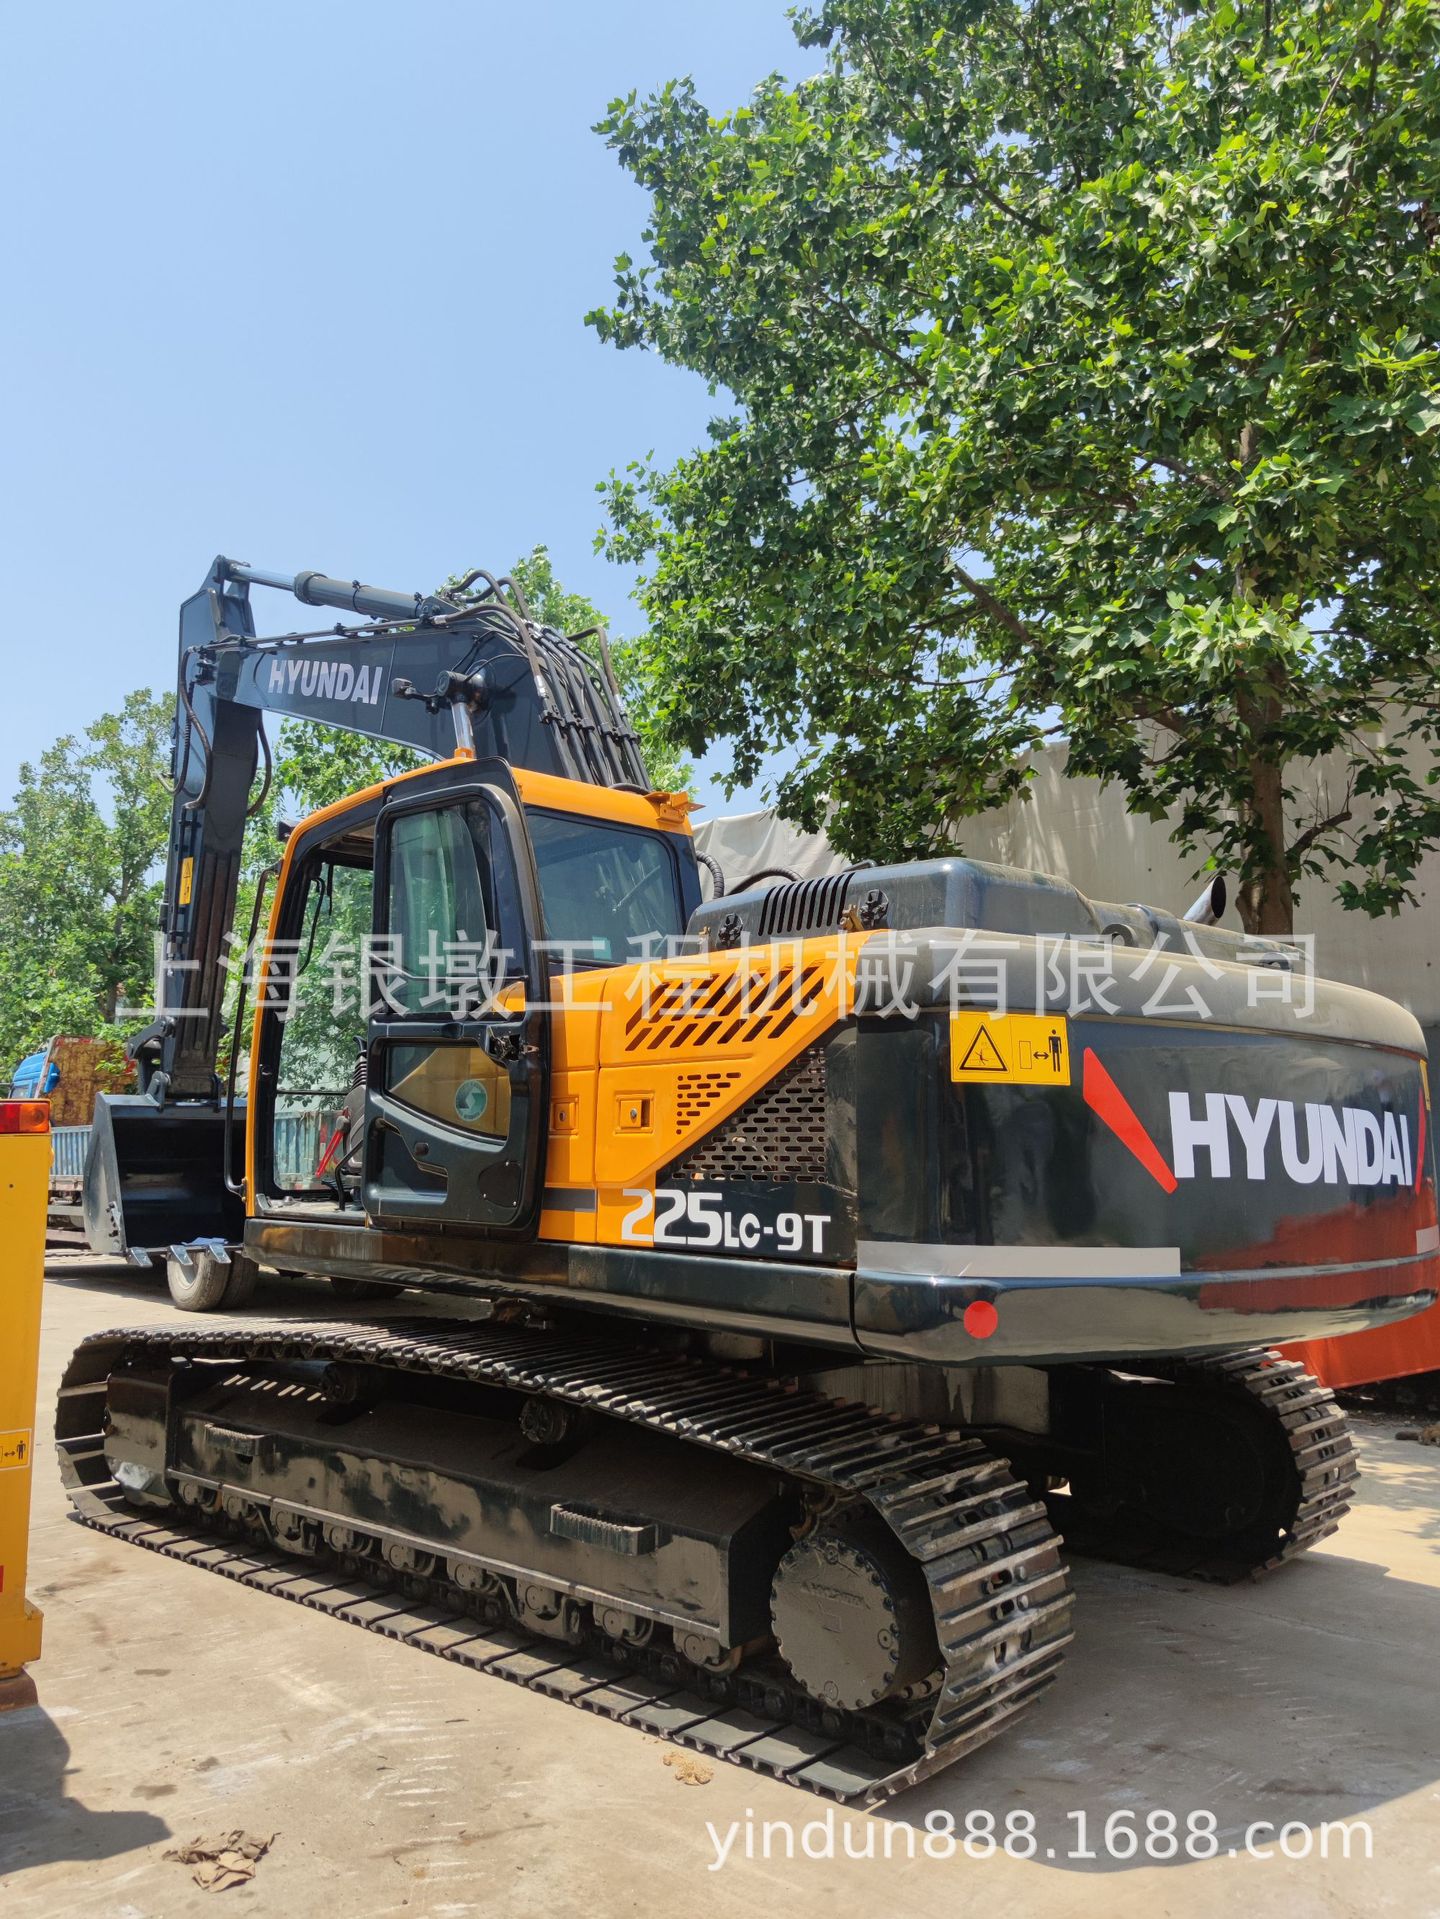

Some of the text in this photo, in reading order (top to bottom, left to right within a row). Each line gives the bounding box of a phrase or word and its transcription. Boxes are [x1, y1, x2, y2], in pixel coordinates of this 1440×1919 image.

[267, 659, 383, 705] HYUNDAI
[1168, 1091, 1413, 1186] HYUNDAI
[621, 1188, 832, 1254] 225LC-9T
